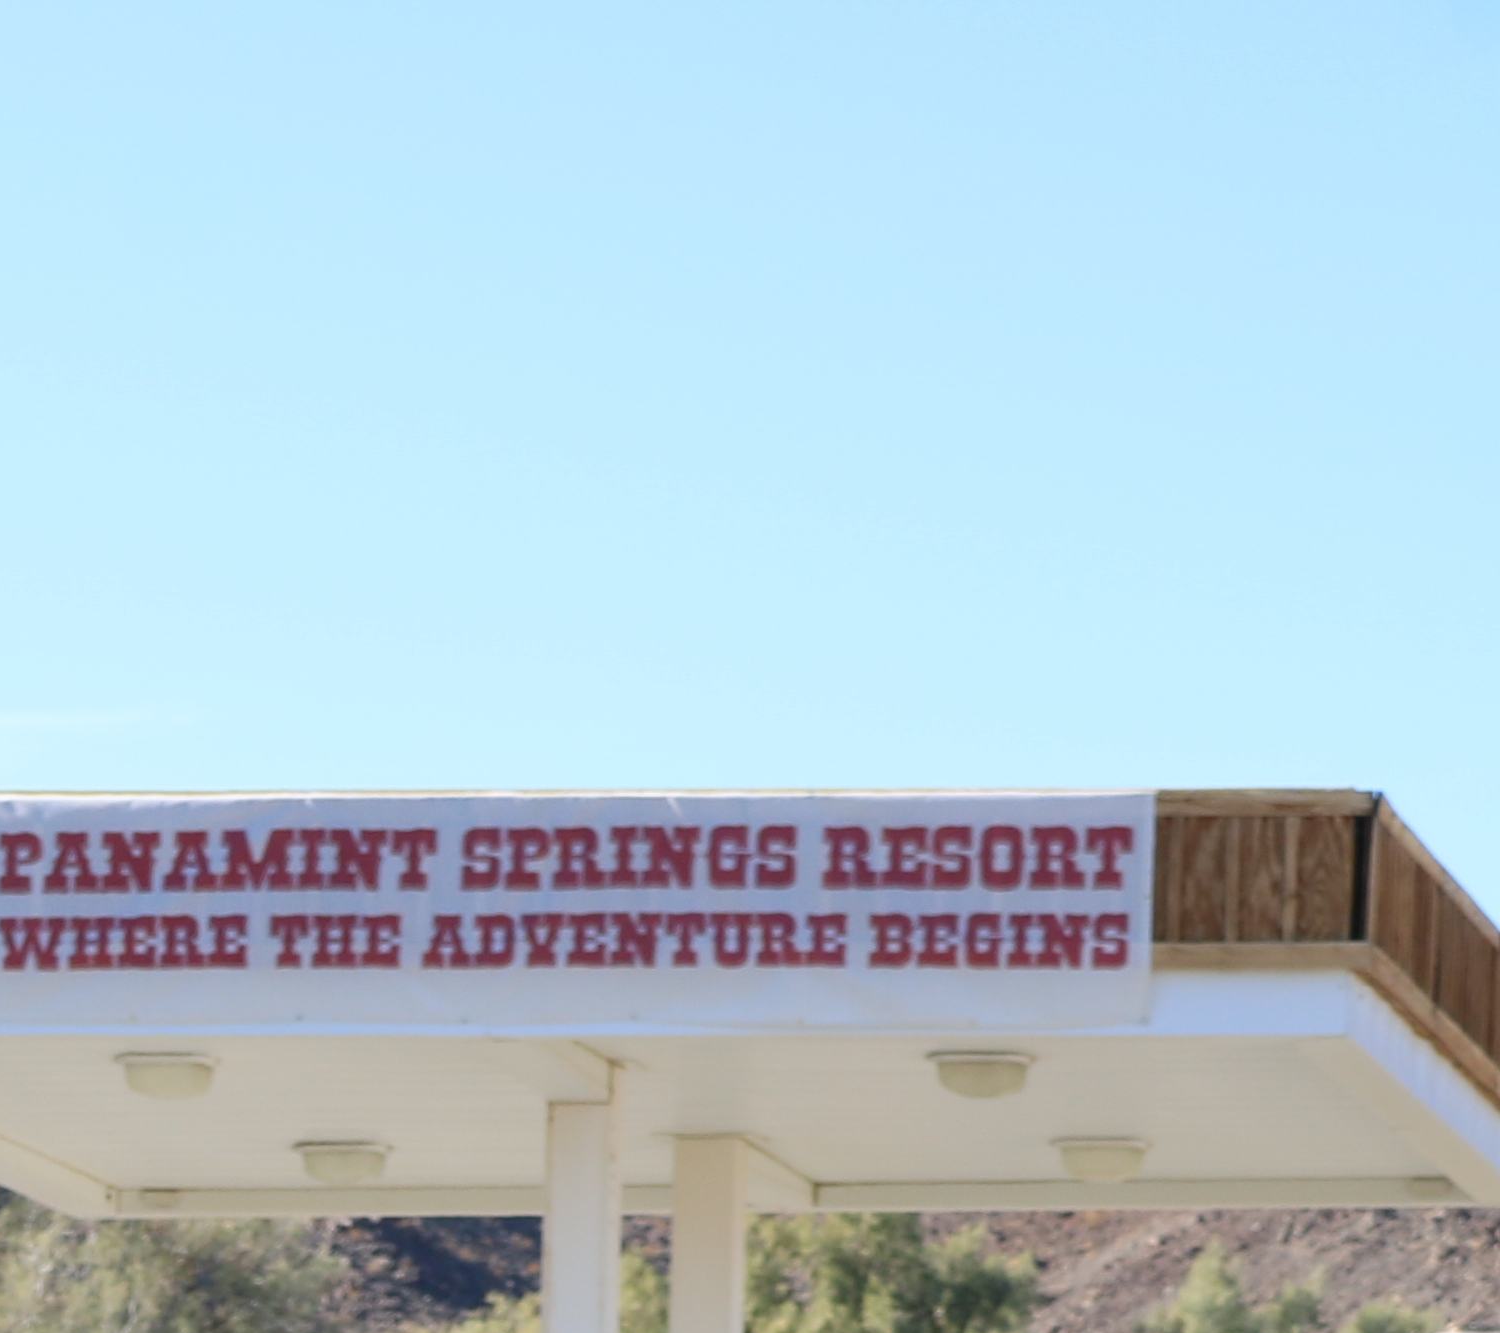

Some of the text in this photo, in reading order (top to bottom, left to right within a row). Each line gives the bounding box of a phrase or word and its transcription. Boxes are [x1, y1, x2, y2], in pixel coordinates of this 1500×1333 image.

[459, 827, 795, 891] SPRINGS
[821, 826, 1135, 891] RESORT
[269, 914, 403, 969] THE
[422, 913, 847, 969] ADVENTURE
[868, 913, 1130, 969] BEGINS
